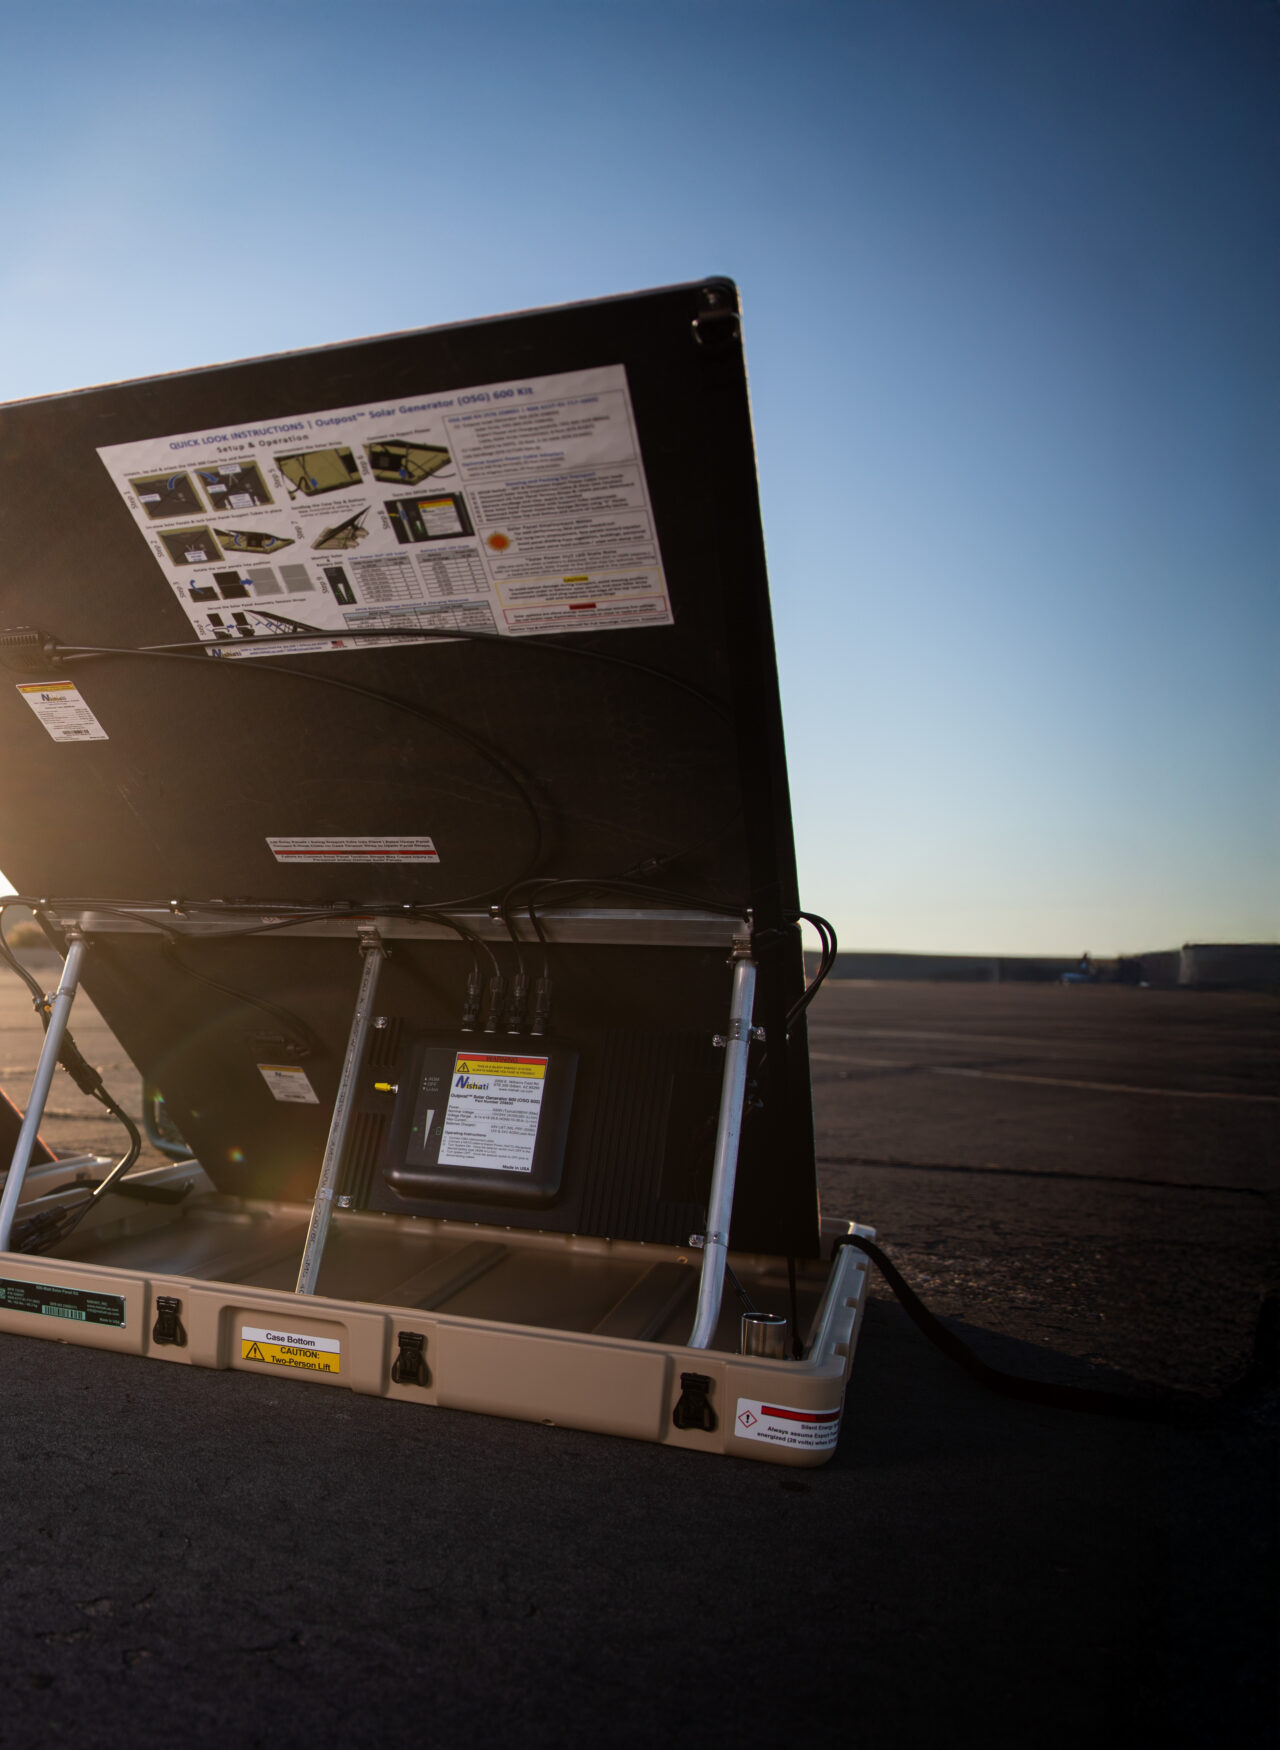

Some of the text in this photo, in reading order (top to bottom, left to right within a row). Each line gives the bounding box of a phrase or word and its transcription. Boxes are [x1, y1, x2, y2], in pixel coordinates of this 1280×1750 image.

[168, 438, 200, 450] QUICK
[201, 434, 229, 445] LOOK
[230, 422, 305, 440] INSTRUCTIONS
[368, 407, 396, 418] Solar
[398, 398, 454, 414] Generator
[456, 392, 491, 407] (OSG)
[492, 388, 514, 399] 600
[516, 385, 533, 396] Kit
[215, 443, 246, 454] Setup
[257, 433, 310, 447] Operation
[455, 1074, 490, 1090] Nishati
[266, 1333, 315, 1347] Case Bottom
[280, 1346, 320, 1360] CAUTION:
[272, 1355, 331, 1372] Two-Person Lift
[757, 1432, 786, 1441] energized
[768, 1426, 788, 1435] Always
